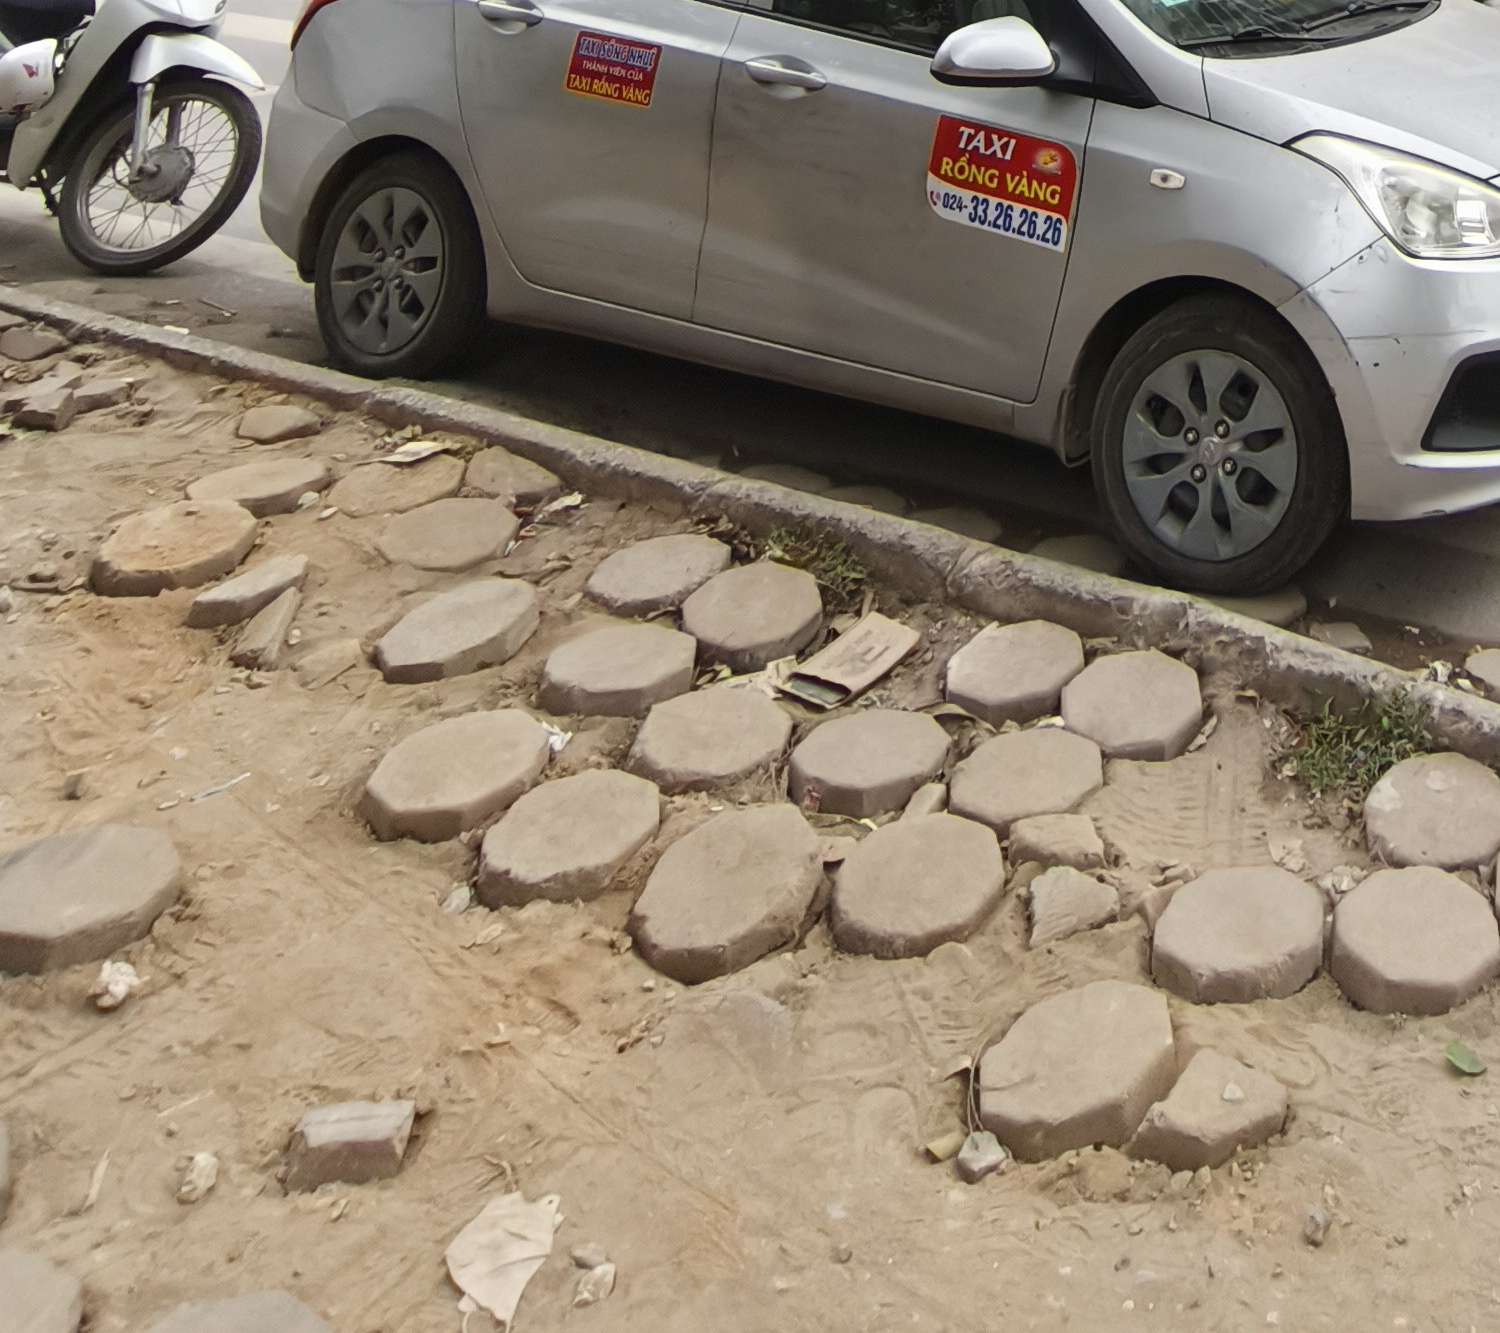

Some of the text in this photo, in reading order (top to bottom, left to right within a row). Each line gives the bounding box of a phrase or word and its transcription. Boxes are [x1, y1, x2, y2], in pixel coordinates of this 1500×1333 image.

[579, 37, 601, 58] TAXI
[600, 38, 629, 63] SÔNG
[569, 74, 591, 90] TAXI
[958, 127, 1016, 160] TAXI
[940, 153, 1061, 205] RỒNG VÀNG
[942, 192, 1063, 247] 024-33.26.26.26
